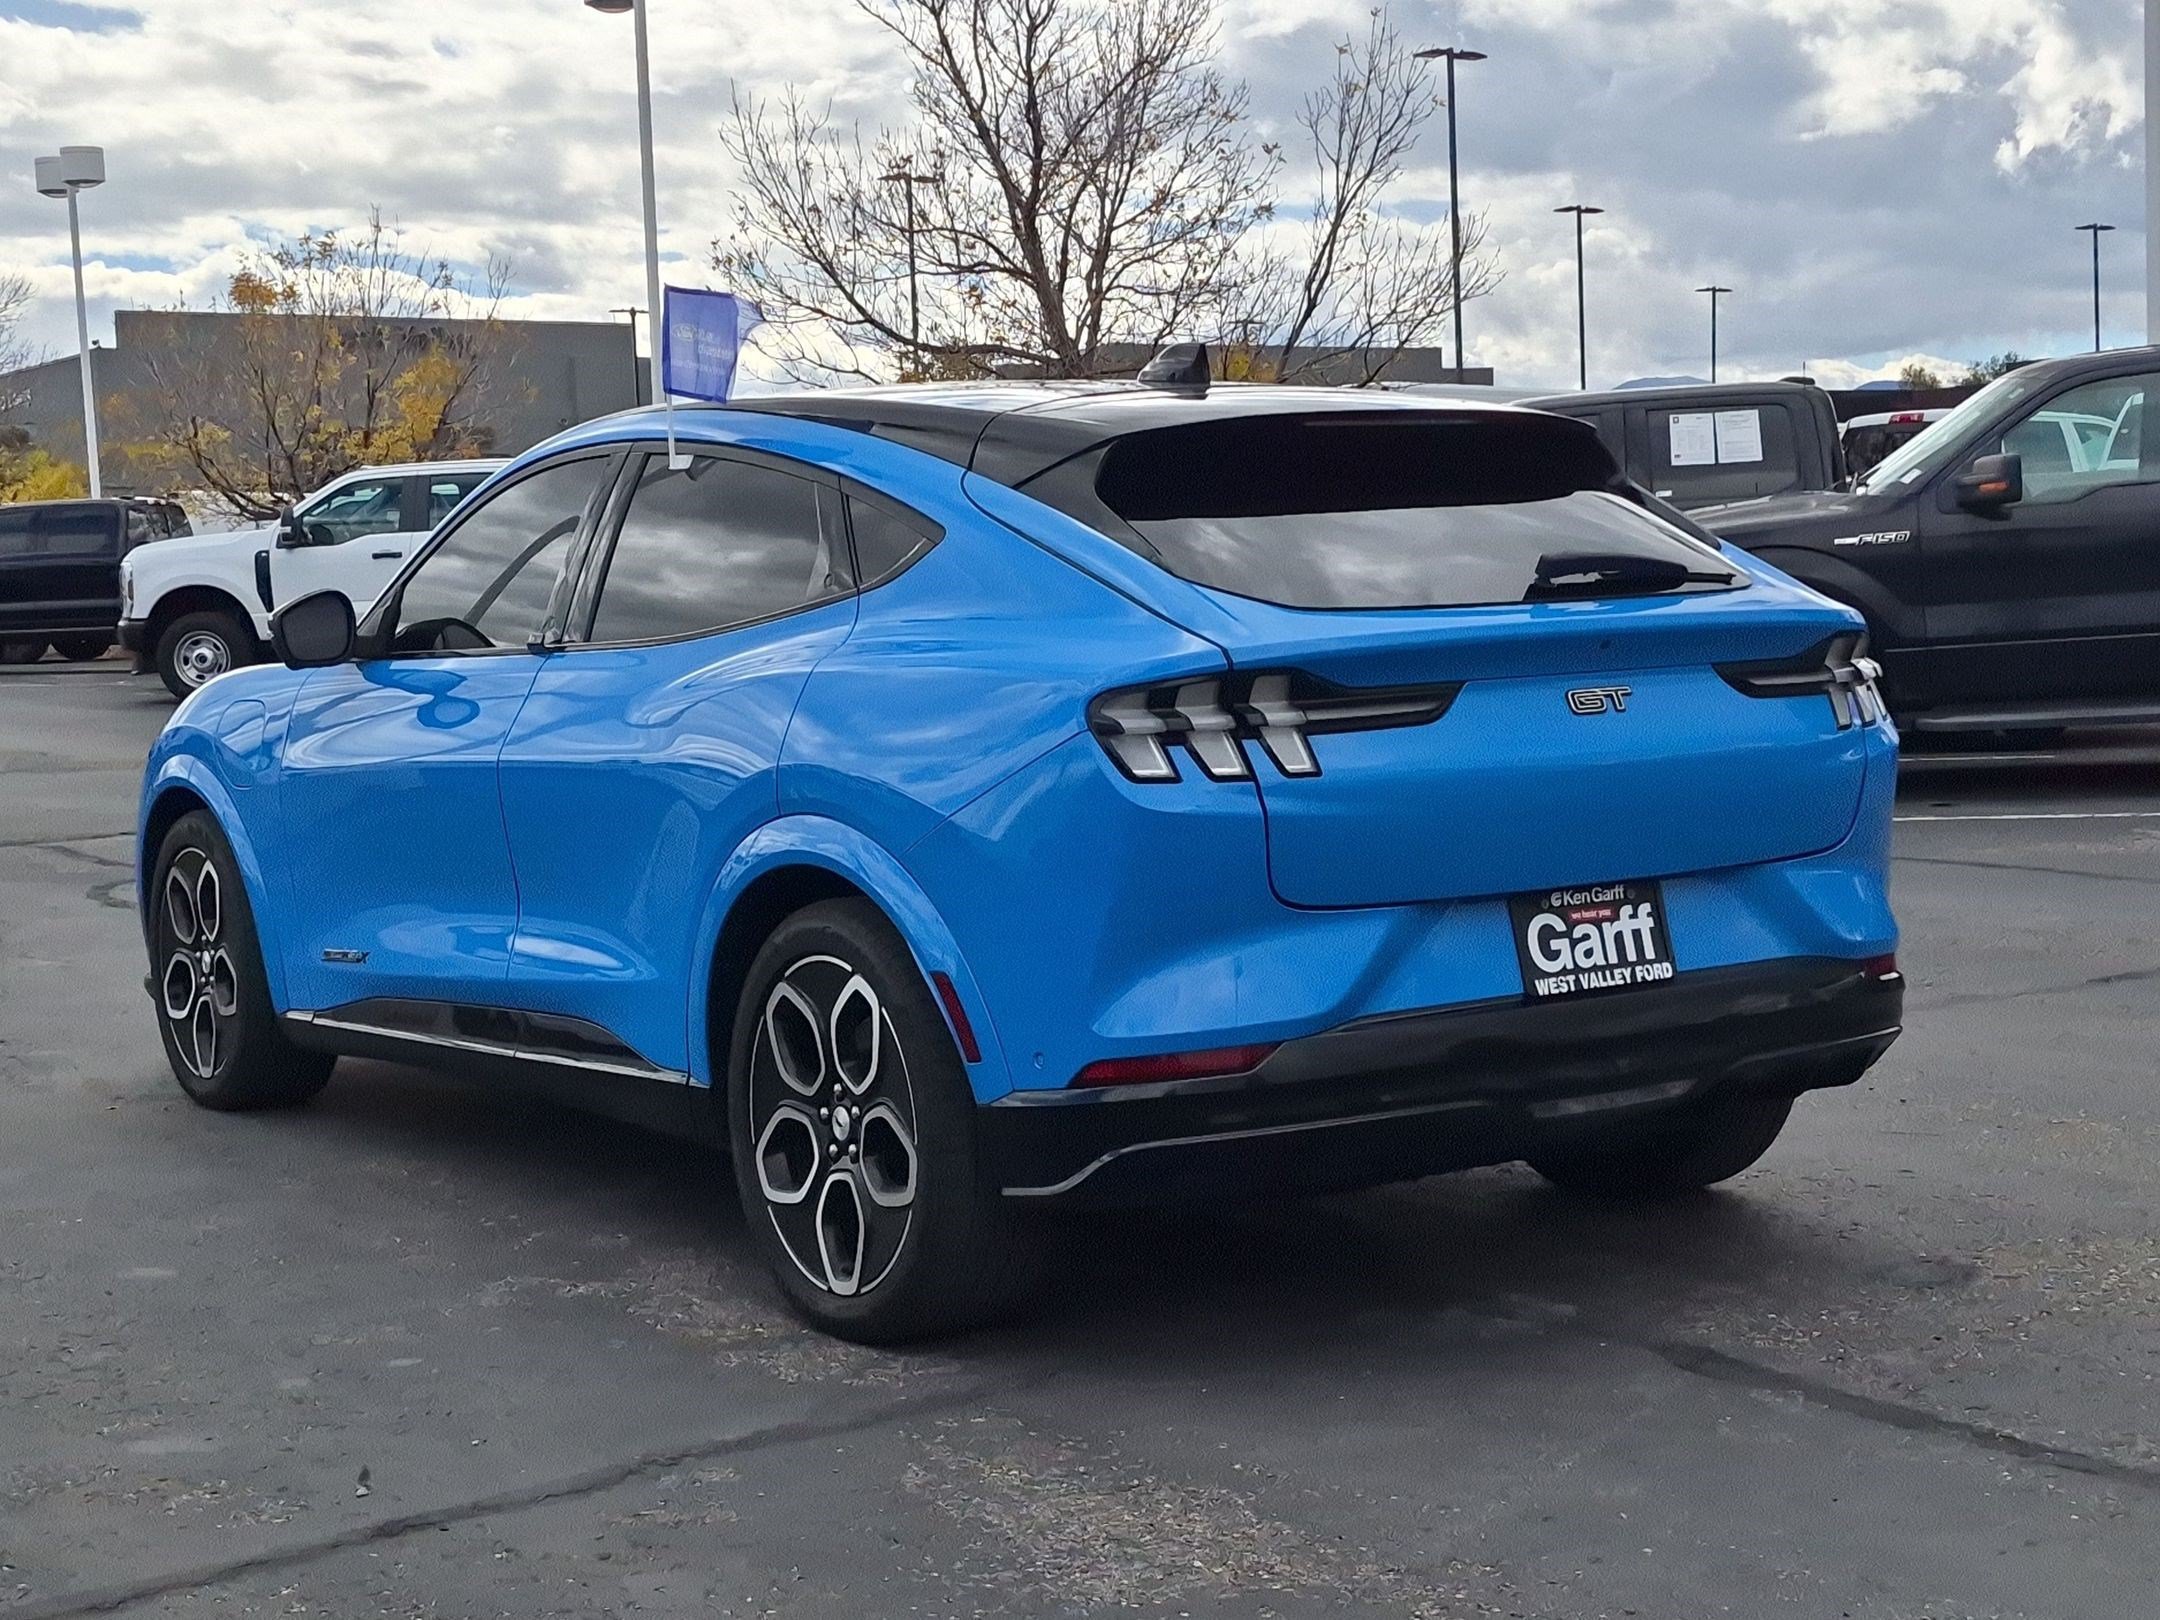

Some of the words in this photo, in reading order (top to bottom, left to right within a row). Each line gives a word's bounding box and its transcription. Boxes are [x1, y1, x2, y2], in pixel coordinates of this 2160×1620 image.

[1565, 685, 1632, 715] GT
[1527, 902, 1656, 974] Garff
[1534, 973, 1577, 997] WEST
[1578, 966, 1633, 990] VALLEY
[1635, 961, 1674, 983] FORD
